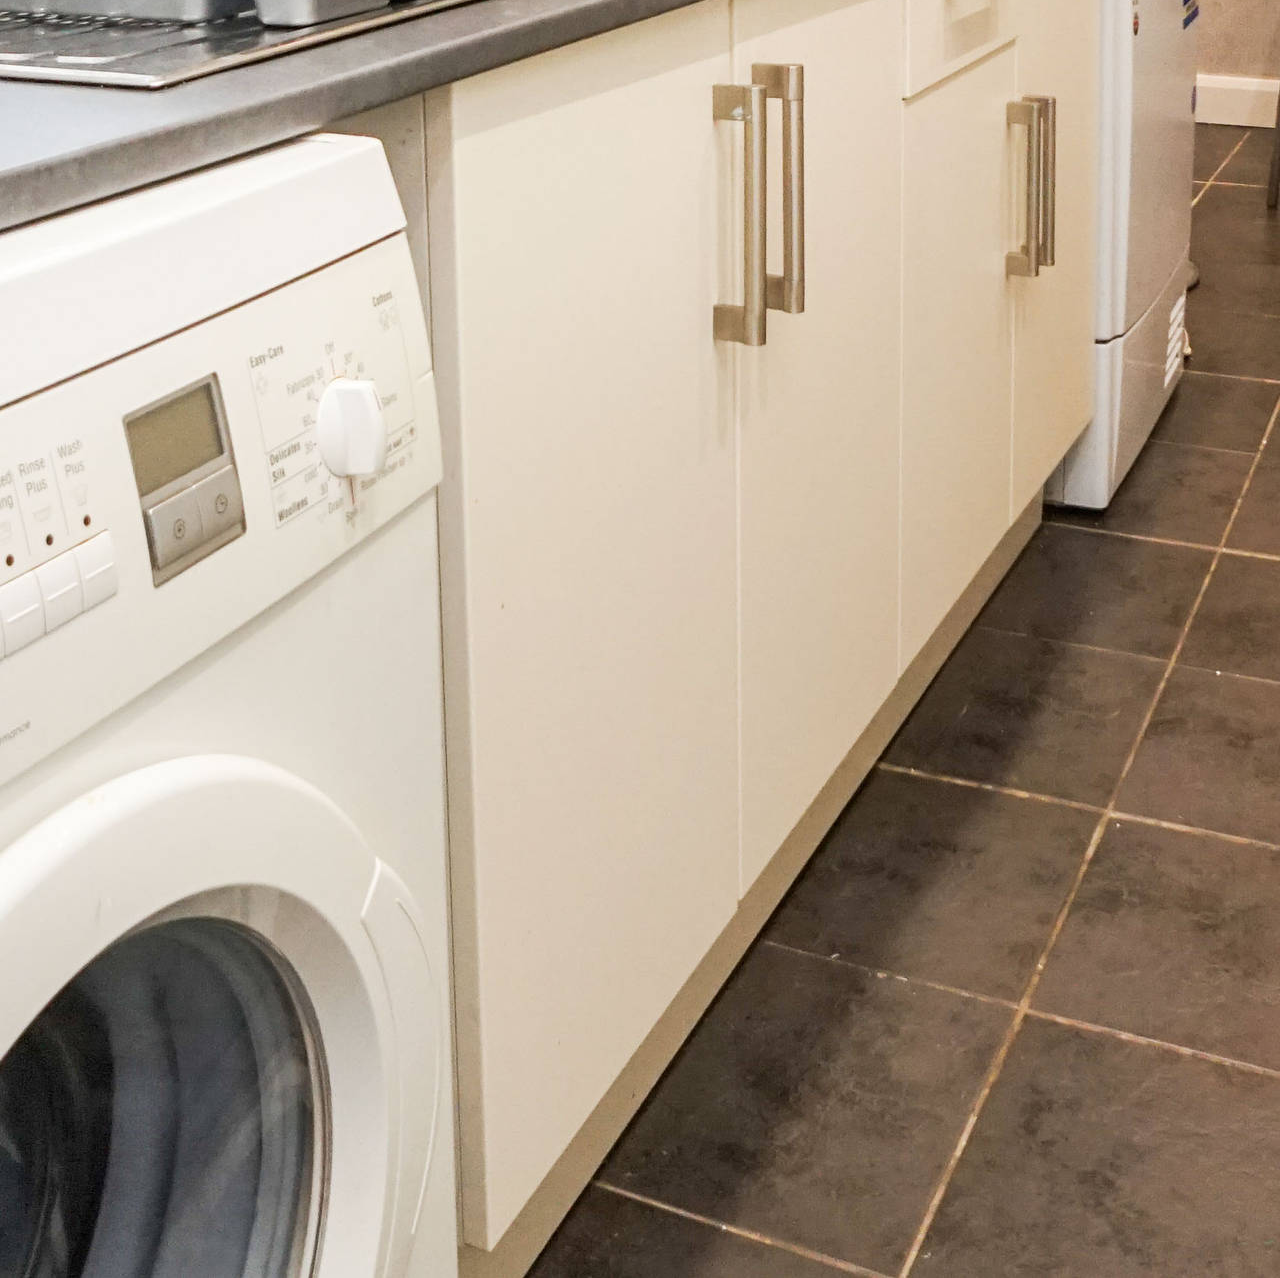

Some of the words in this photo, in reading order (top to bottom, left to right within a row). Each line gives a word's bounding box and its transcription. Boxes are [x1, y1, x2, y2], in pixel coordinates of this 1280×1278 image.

[249, 344, 285, 369] Easy-Care
[57, 439, 83, 460] Wash
[270, 442, 301, 466] Delicates
[19, 456, 47, 478] Rinse
[65, 460, 86, 478] Plus
[272, 468, 286, 483] Silk
[26, 477, 48, 497] Plus
[278, 496, 309, 522] Woollens
